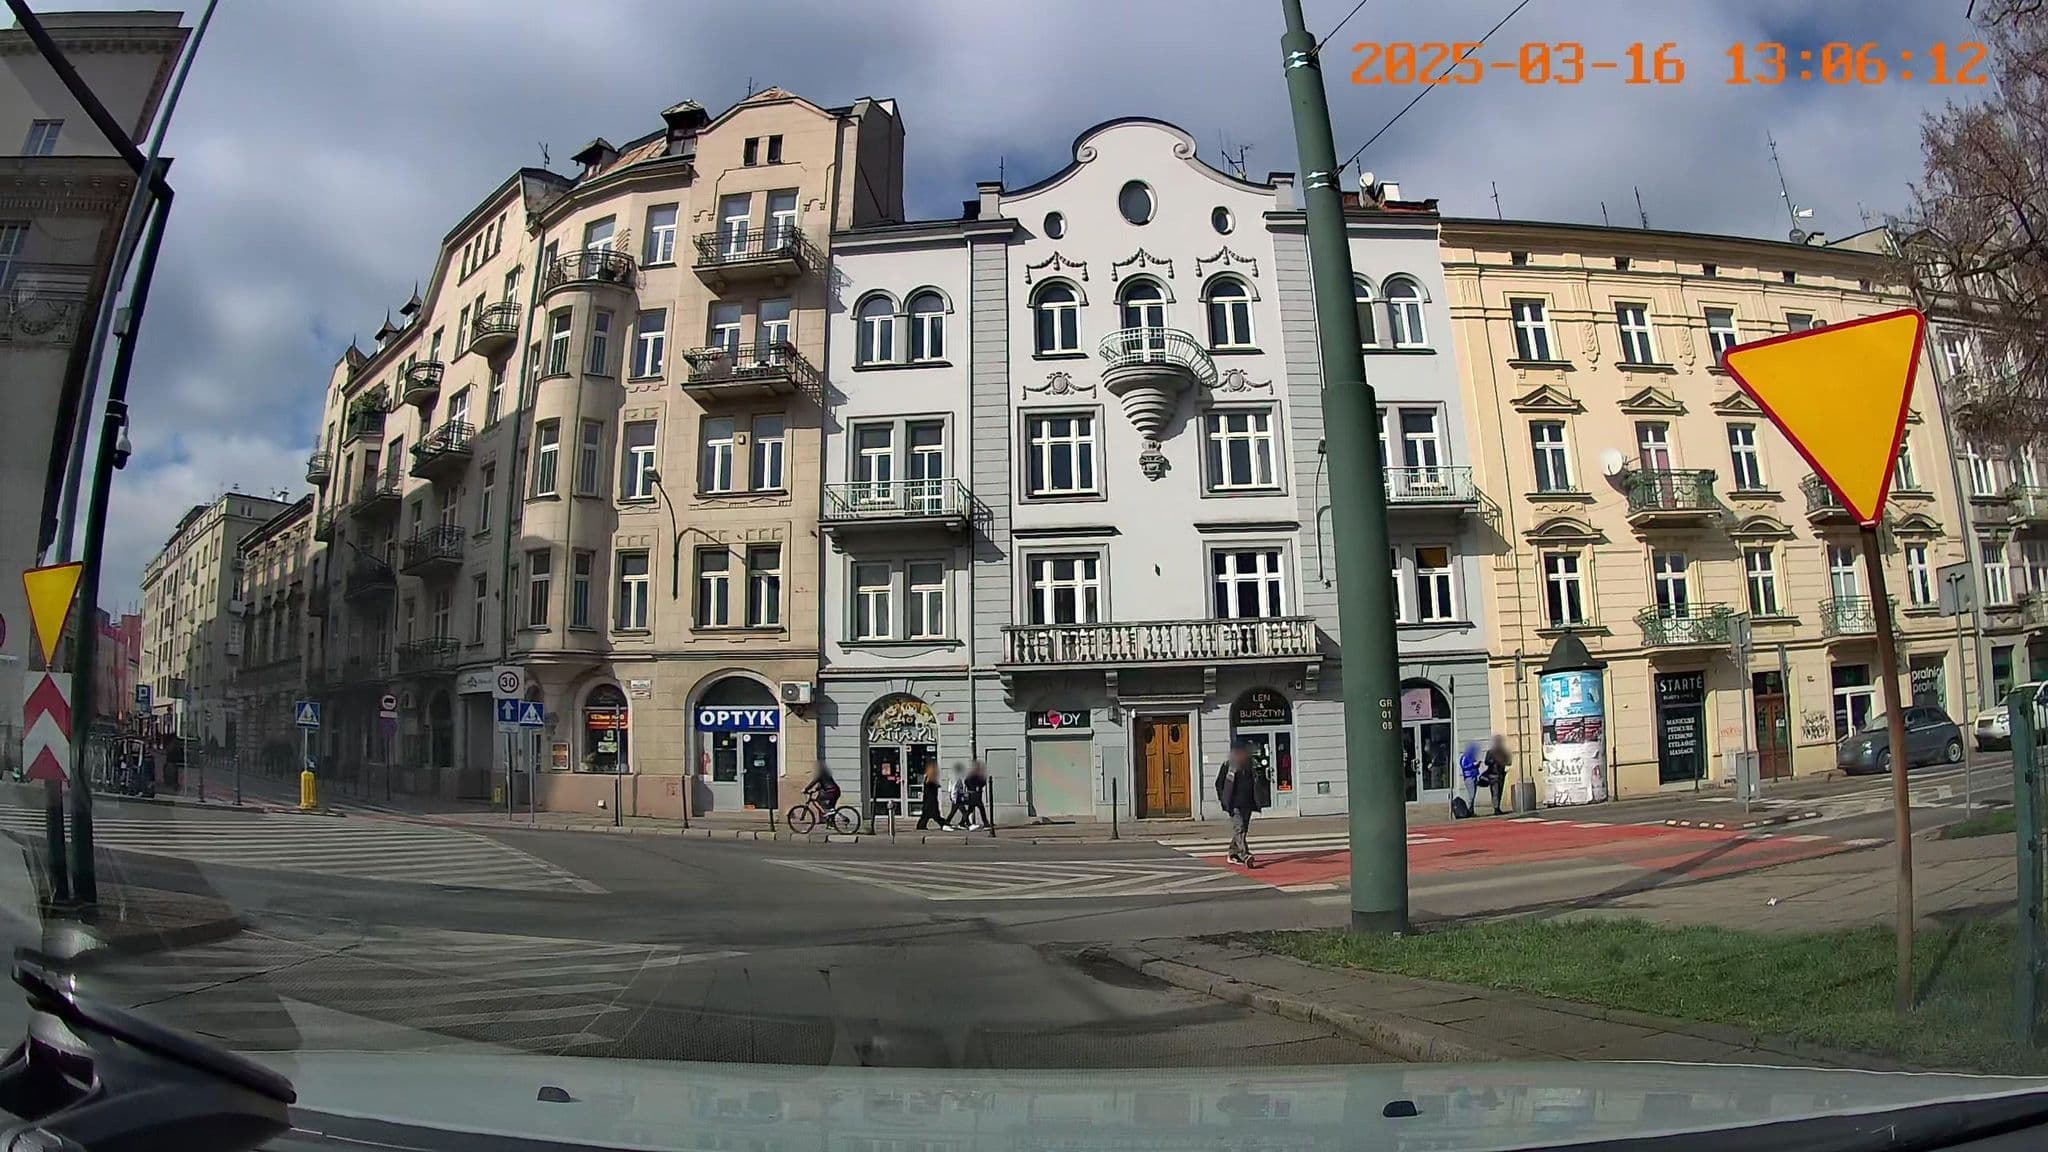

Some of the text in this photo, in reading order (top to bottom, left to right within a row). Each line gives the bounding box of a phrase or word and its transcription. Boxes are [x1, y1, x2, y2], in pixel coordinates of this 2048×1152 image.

[501, 677, 516, 688] 30
[1252, 693, 1271, 702] LEN
[1379, 699, 1393, 708] GR
[1240, 708, 1285, 718] BURSZTYN
[1381, 711, 1392, 719] 01
[700, 710, 775, 726] OPTYK
